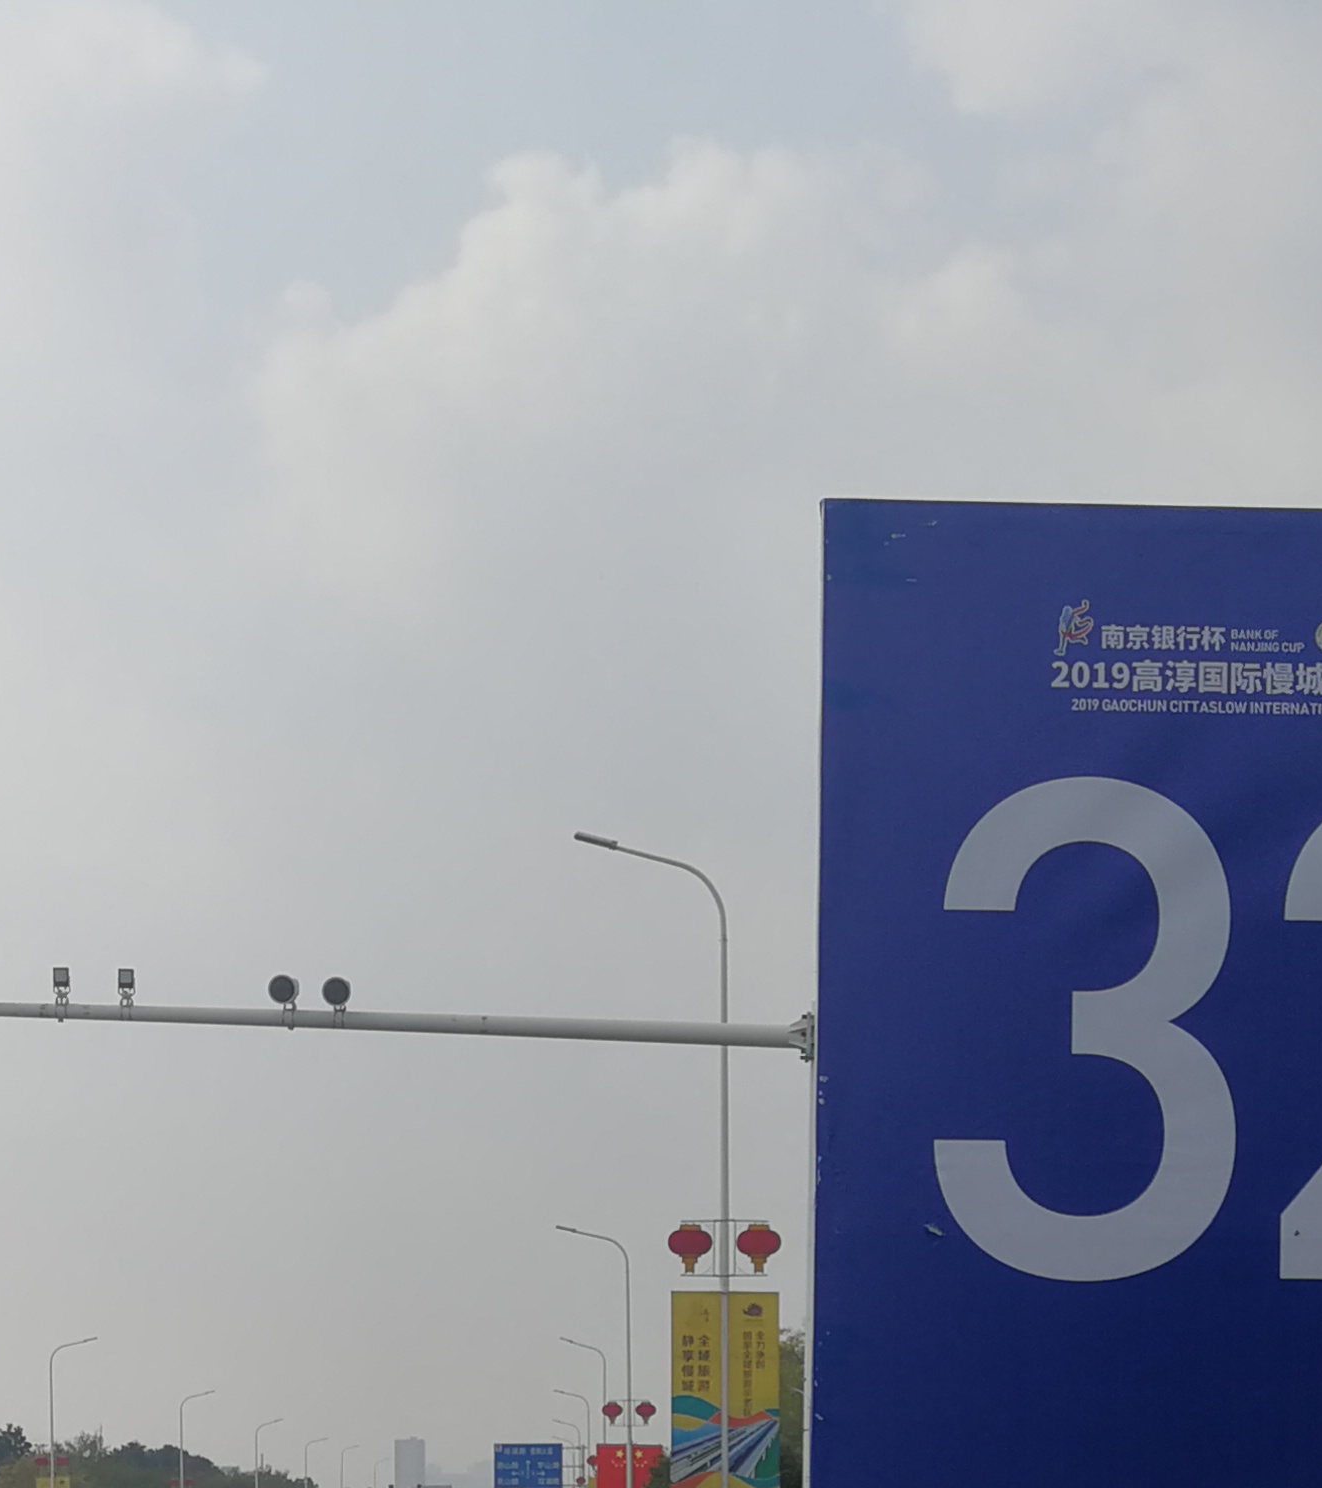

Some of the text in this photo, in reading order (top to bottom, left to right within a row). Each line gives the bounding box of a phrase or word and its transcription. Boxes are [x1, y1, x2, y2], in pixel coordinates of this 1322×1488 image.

[1101, 624, 1226, 651] 南京银行杯
[1230, 628, 1278, 640] BANK OF
[1230, 641, 1305, 653] NANJING CUP
[1071, 698, 1099, 711] 2019
[1102, 699, 1167, 712] GAOCHUN
[1169, 700, 1247, 714] CITTASLOW
